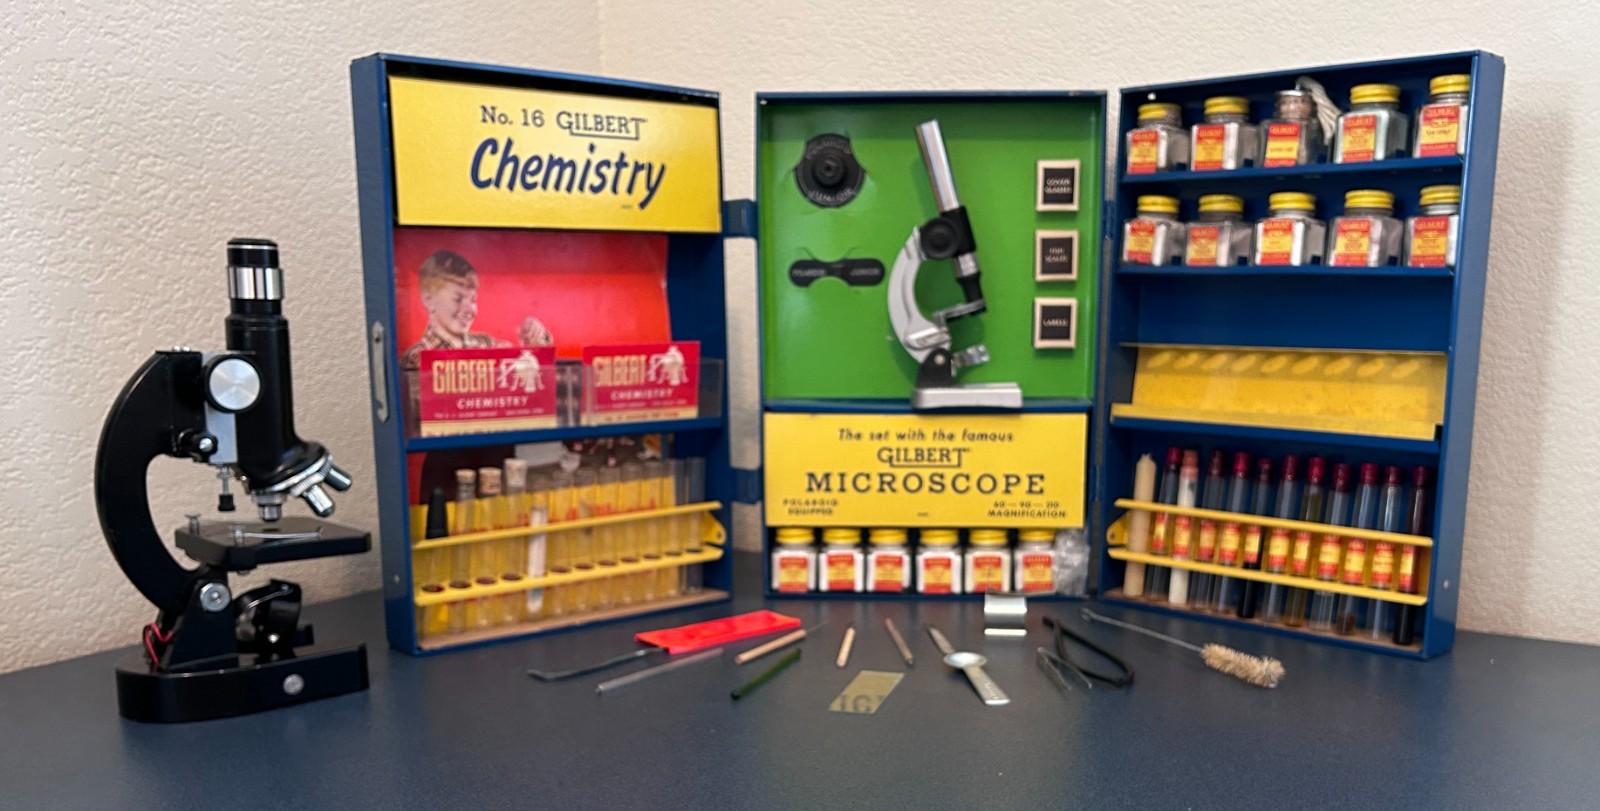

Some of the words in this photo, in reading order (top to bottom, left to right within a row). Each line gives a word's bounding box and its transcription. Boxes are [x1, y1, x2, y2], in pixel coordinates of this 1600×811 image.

[480, 105, 513, 126] No.
[521, 108, 545, 127] 16
[556, 111, 643, 140] GILBERT
[470, 136, 667, 210] Chemistry
[432, 358, 497, 394] GILBERT
[593, 355, 648, 387] GILBERT
[457, 395, 529, 410] CHEMISTRY
[838, 428, 863, 441] The
[869, 430, 890, 441] set
[896, 429, 926, 441] with
[932, 429, 956, 441] the
[961, 429, 1014, 442] famous
[877, 447, 965, 468] GILBERT
[805, 472, 1046, 495] MICROSCOPE
[988, 509, 1067, 518] MAGNIFICATION
